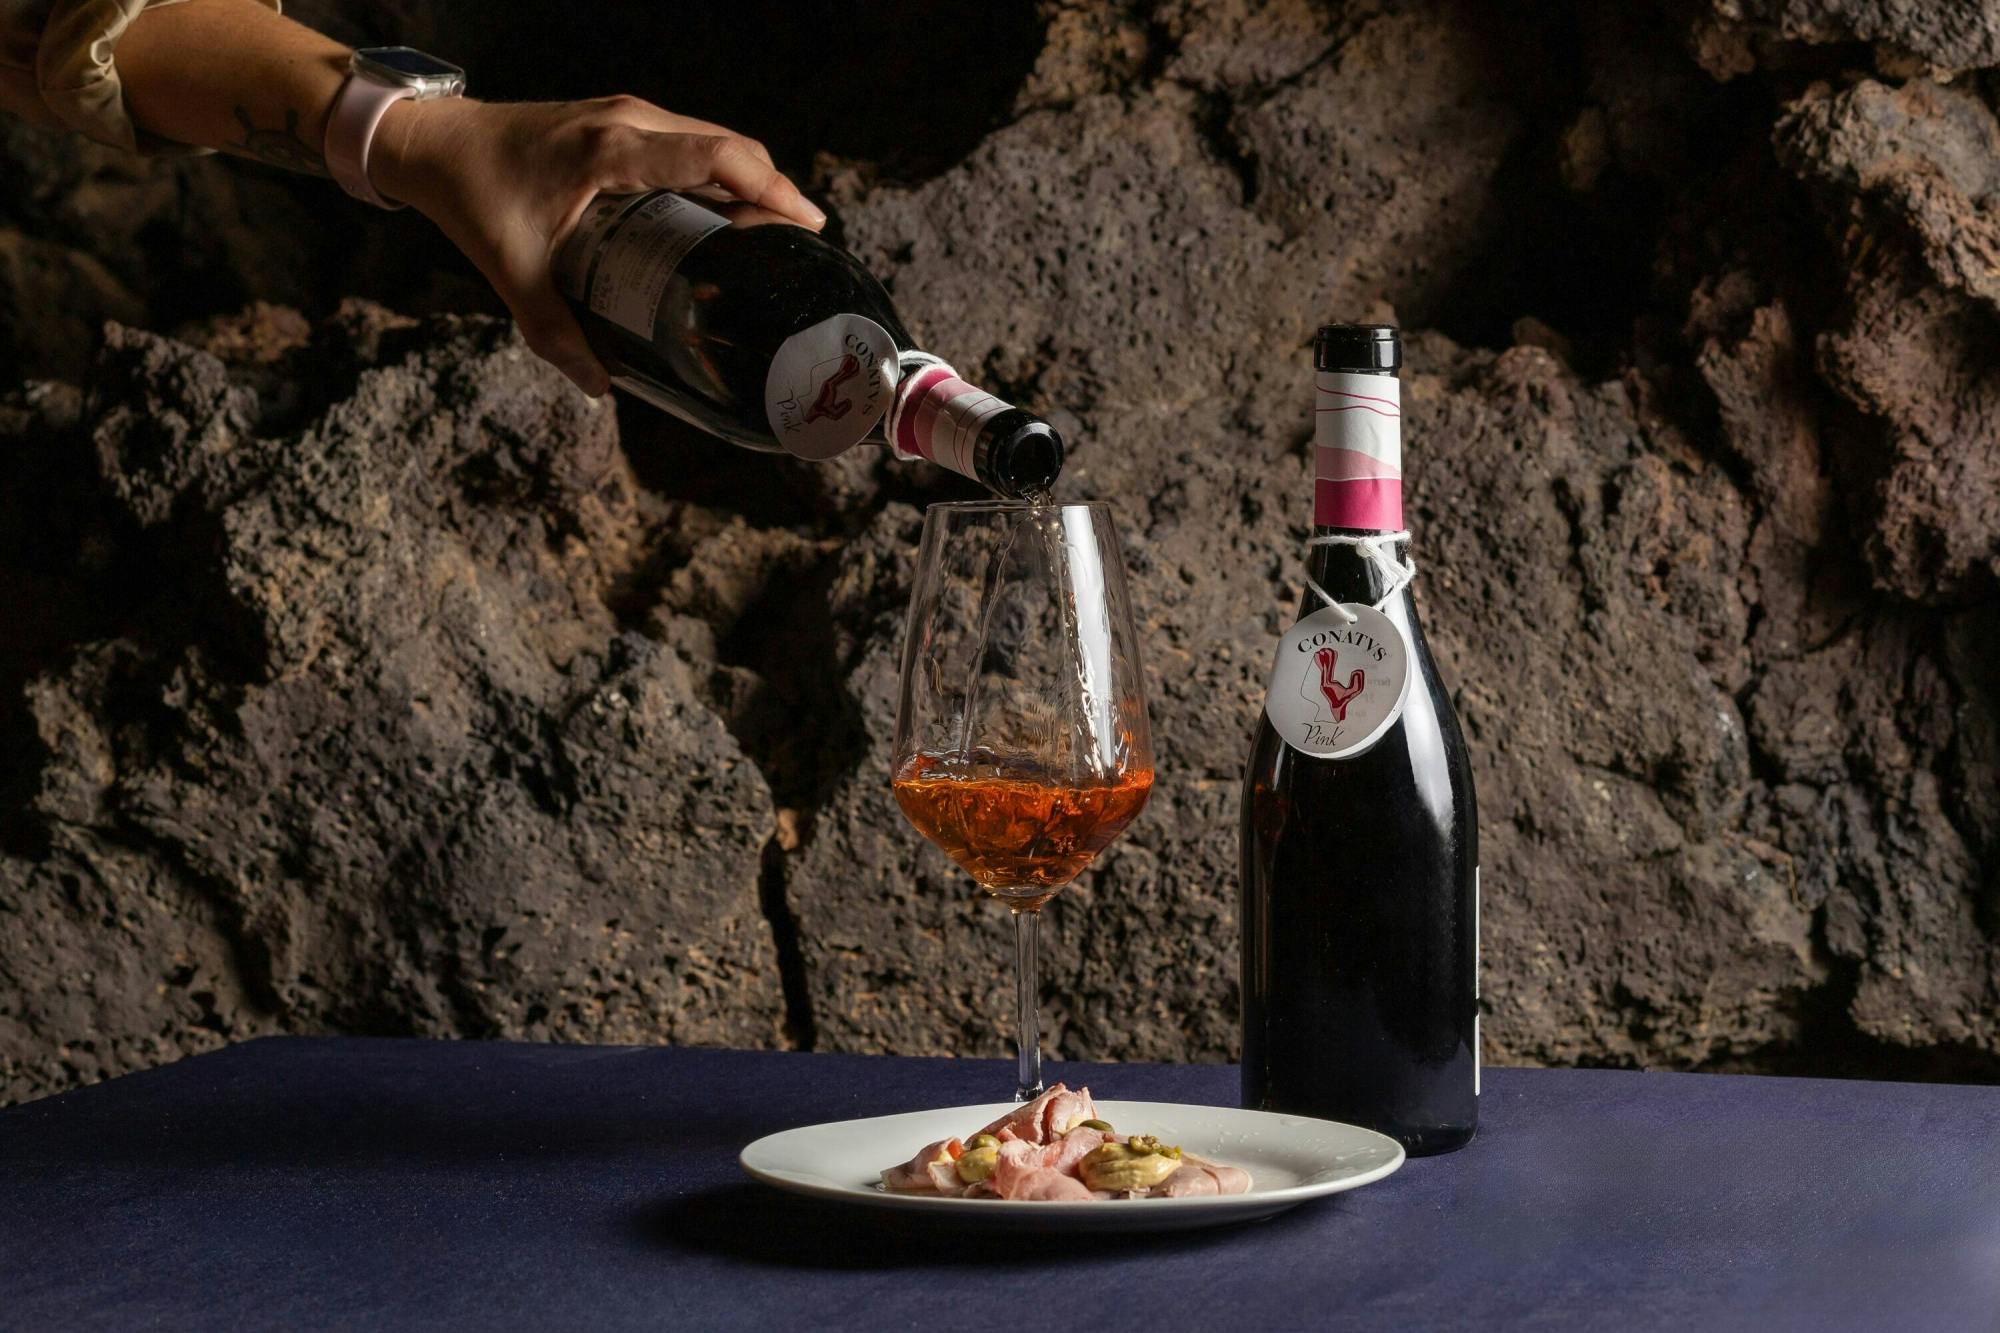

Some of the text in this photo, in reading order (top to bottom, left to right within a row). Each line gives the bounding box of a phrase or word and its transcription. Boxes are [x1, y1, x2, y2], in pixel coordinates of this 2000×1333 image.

[845, 333, 881, 415] CONATVS
[777, 387, 801, 434] Pink
[1298, 630, 1388, 662] CONATVS
[1303, 722, 1345, 747] Pink
